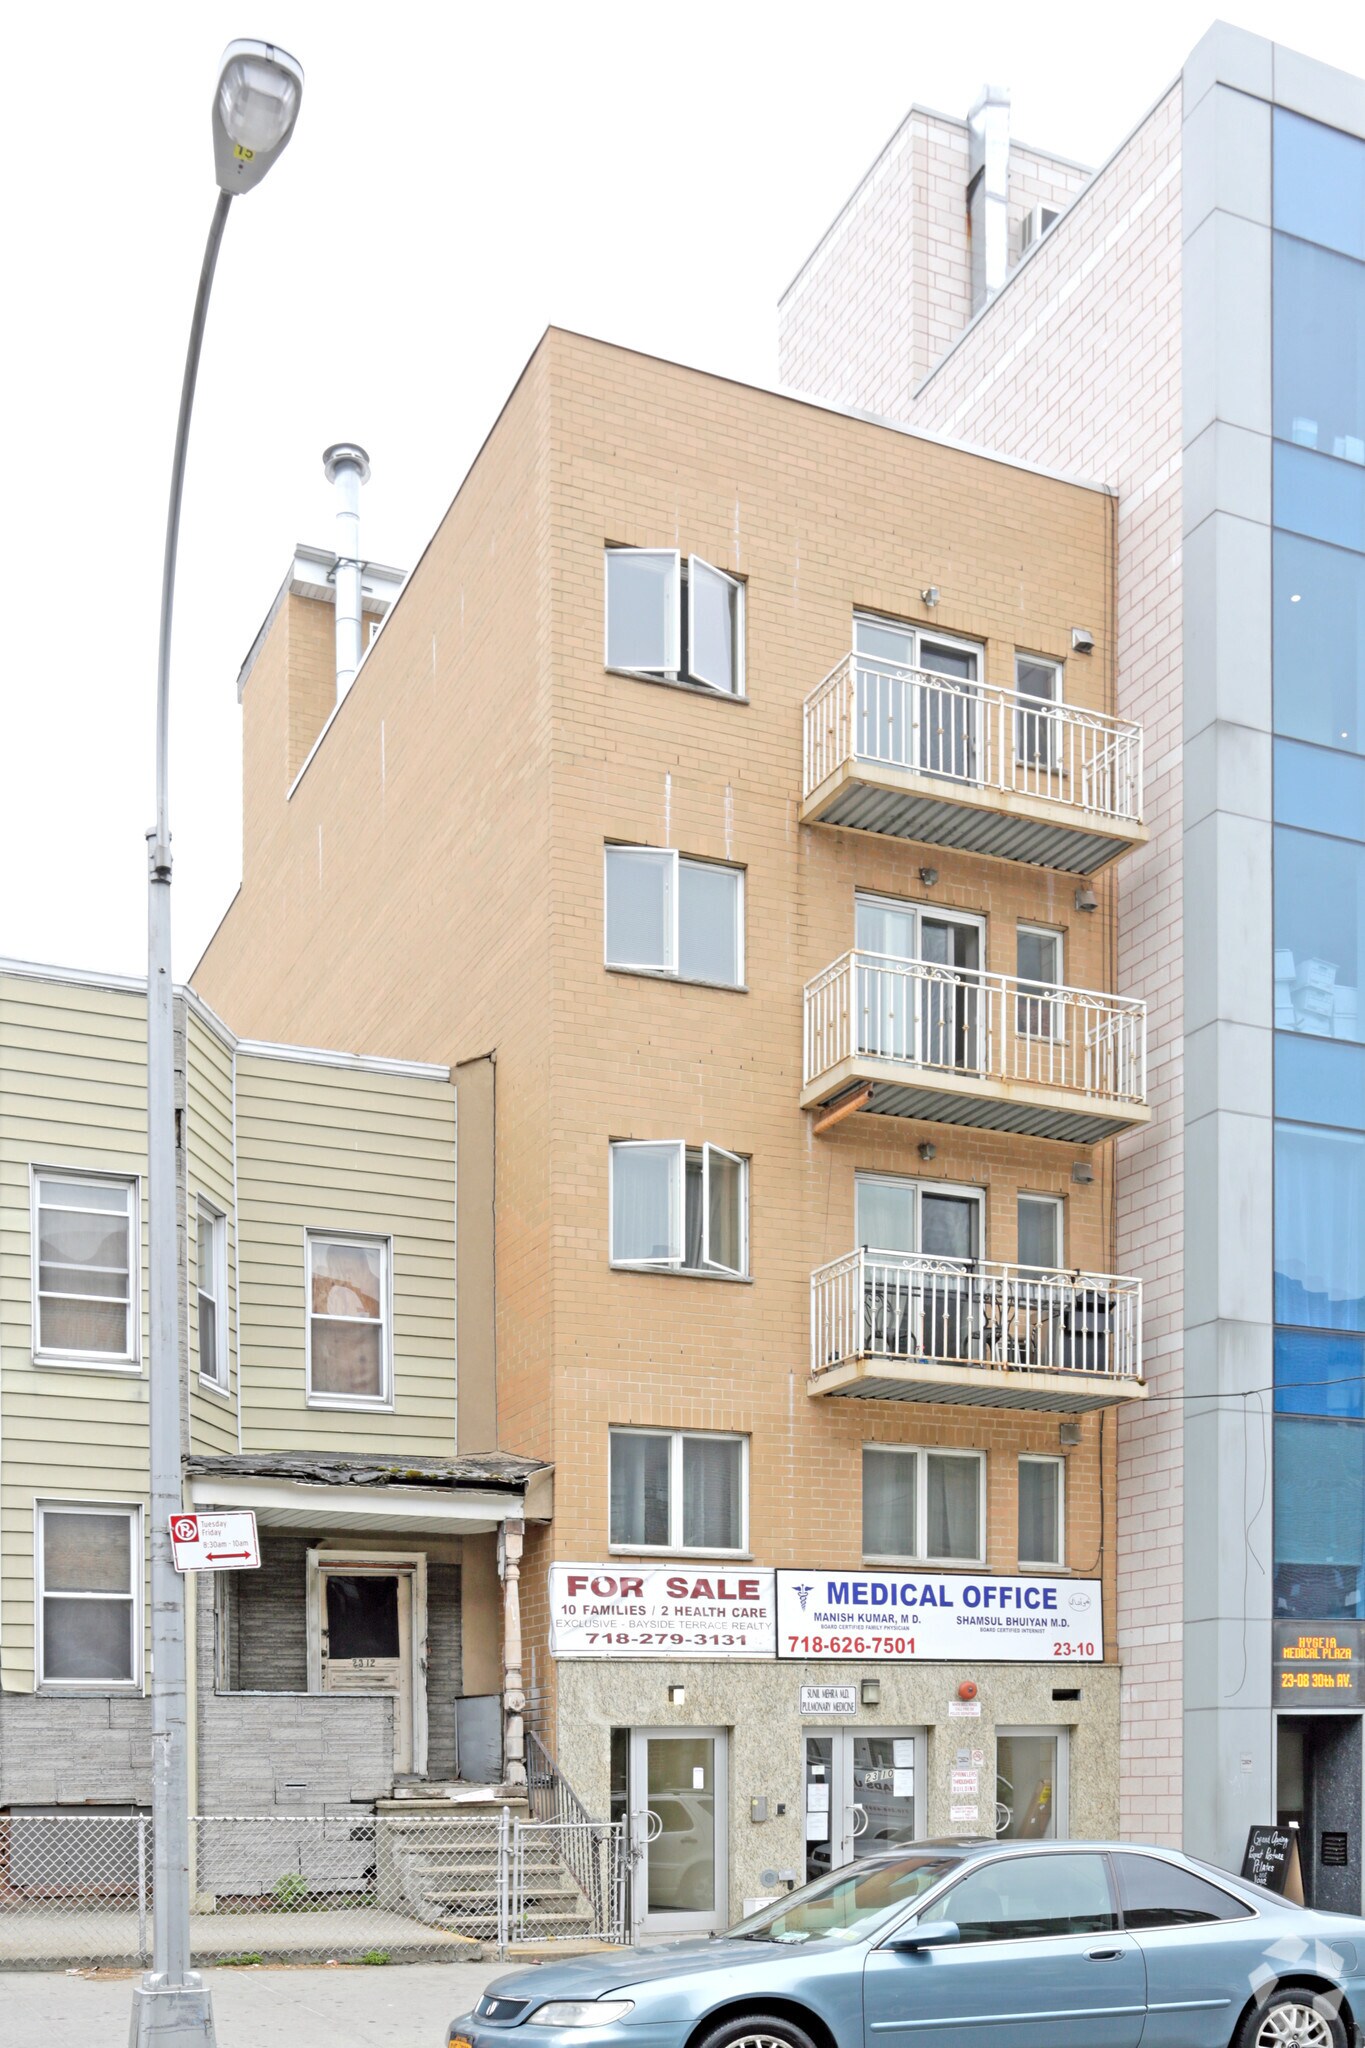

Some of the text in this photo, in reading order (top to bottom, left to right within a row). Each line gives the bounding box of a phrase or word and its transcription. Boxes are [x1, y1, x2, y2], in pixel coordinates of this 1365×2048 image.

[567, 1576, 760, 1600] FOR SALE
[827, 1582, 953, 1607] MEDICAL
[963, 1585, 1058, 1610] OFFICE
[561, 1605, 766, 1618] 10 FAMILIES / 2 HEALTH CARE
[556, 1619, 617, 1628] EXCLUSIVE
[629, 1620, 675, 1629] BAYSIDE
[679, 1621, 728, 1630] TERRACE
[732, 1622, 772, 1630] REALTY
[814, 1612, 854, 1622] MANISH
[858, 1614, 897, 1625] KUMAR,
[956, 1616, 1070, 1627] SHAMSUL BHUIYAN M.D.
[586, 1633, 746, 1645] 718-279-3131
[788, 1636, 915, 1654] 718-626-7501
[1299, 1637, 1336, 1648] HYGEIA
[1054, 1642, 1094, 1656] 23-10
[1283, 1647, 1352, 1659] MEDICAL PLAZA
[352, 1659, 375, 1668] 2312
[1282, 1673, 1352, 1687] 23-08 30th AV.
[807, 1689, 820, 1698] SUNIL
[803, 1702, 854, 1711] PULMONARY MEDICINE
[1254, 1830, 1288, 1849] Grand Opening
[1253, 1859, 1274, 1873] Pilates
